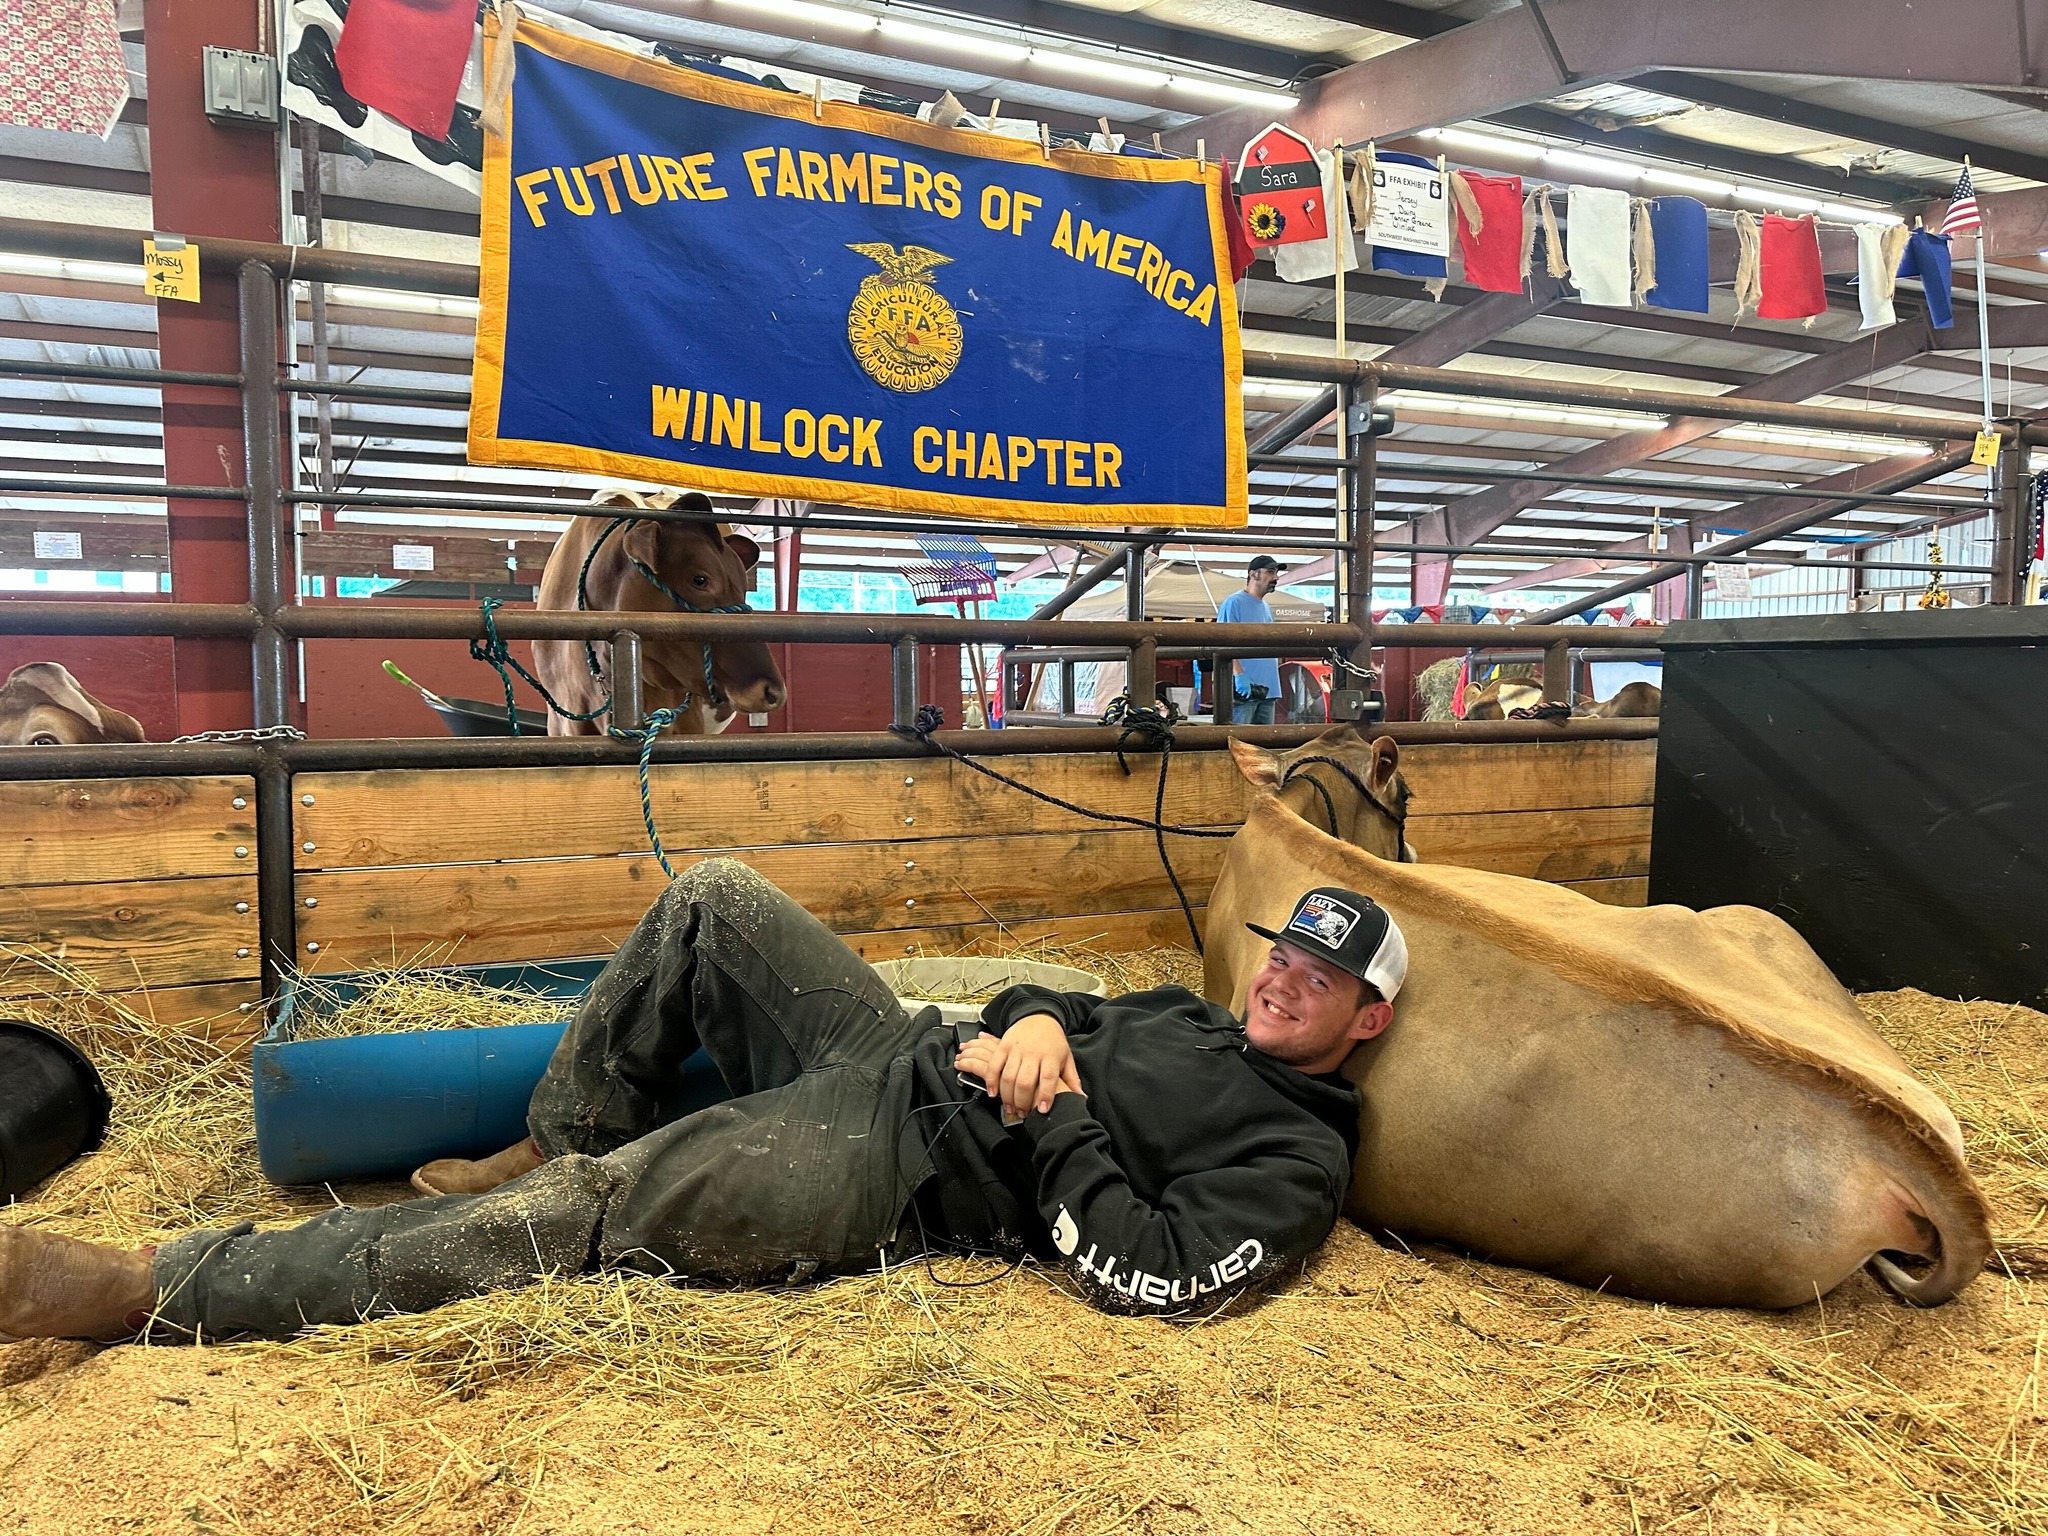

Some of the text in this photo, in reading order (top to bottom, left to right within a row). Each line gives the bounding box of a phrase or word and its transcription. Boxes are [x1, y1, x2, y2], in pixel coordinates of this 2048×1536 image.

[1260, 166, 1297, 187] Sara
[1389, 175, 1427, 190] FFA EXHIBIT
[1396, 191, 1418, 209] Jersey
[1398, 205, 1417, 219] Dairy
[515, 146, 1217, 327] FUTURE FARMERS OF AMERICA
[1378, 232, 1402, 242] SOUTHWEST
[1402, 236, 1430, 247] WASHINGTON
[146, 253, 184, 274] Mossy
[154, 284, 179, 297] FFA
[868, 295, 947, 340] AGRICULTURAL
[872, 348, 940, 377] EDUCATION
[652, 384, 1122, 488] WINLOCK CHAPTER
[1309, 897, 1337, 911] LAZY
